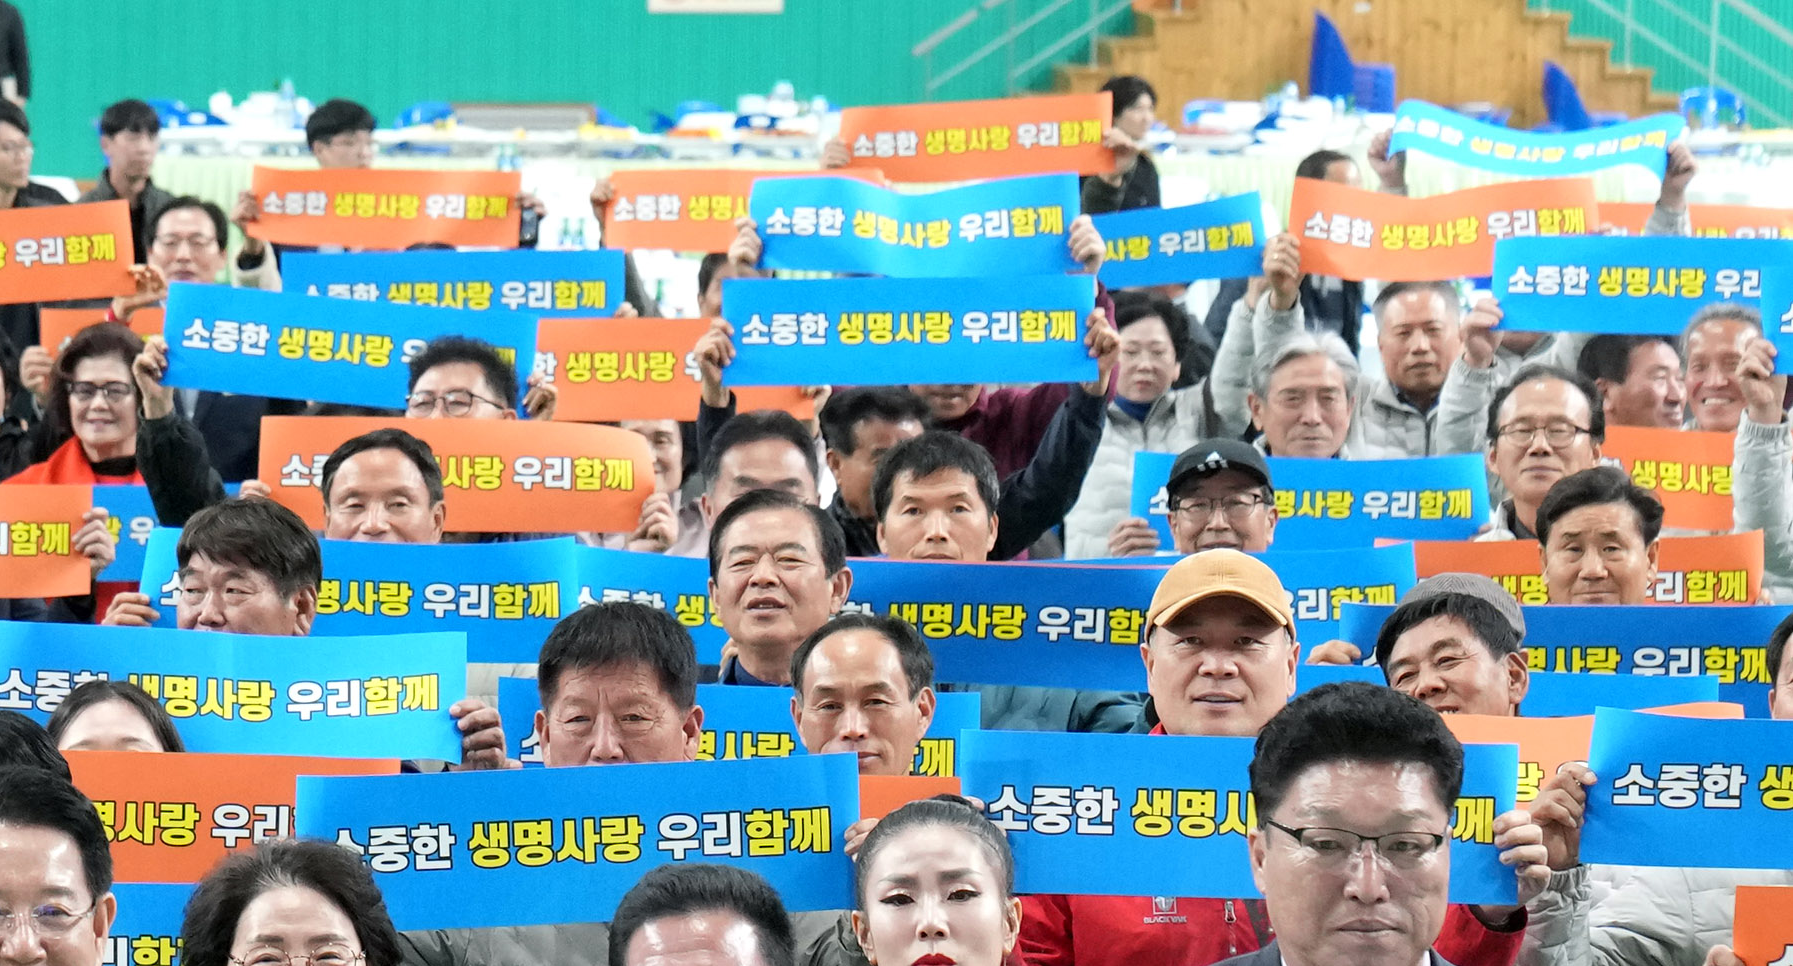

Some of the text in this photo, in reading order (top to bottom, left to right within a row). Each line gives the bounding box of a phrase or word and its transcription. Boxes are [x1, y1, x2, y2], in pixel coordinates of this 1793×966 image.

[853, 119, 1102, 158] 소중한 생명사랑 우리함께
[263, 190, 508, 222] 소중한 생명사랑 우리함께
[613, 195, 683, 222] 소중한
[765, 205, 1064, 250] 소중한 생명사랑 우리함께
[1105, 220, 1255, 265] 사랑 우리함께
[1303, 207, 1585, 251] 소중한 생명사랑 우리함께
[14, 233, 116, 268] 우리함께
[386, 281, 494, 311] 생명사랑
[500, 279, 606, 311] 우리함께
[1507, 264, 1762, 300] 소중한 생명사랑 우리
[181, 318, 271, 356] 소중한
[277, 326, 394, 368] 생명사랑
[741, 310, 1077, 346] 소중한 생명사랑 우리함께
[565, 351, 677, 383] 생명사랑
[441, 455, 505, 490] 사랑
[512, 456, 634, 491] 우리함께
[1274, 488, 1472, 521] 명사랑 우리함께
[316, 580, 560, 620] 명사랑 우리함께
[1037, 606, 1147, 646] 우리함
[286, 673, 439, 722] 우리함께
[1613, 764, 1747, 808] 소중한
[212, 804, 295, 847] 우리
[990, 785, 1255, 838] 소중한 생명사
[467, 815, 645, 869] 생명사랑
[657, 806, 831, 861] 우리함께
